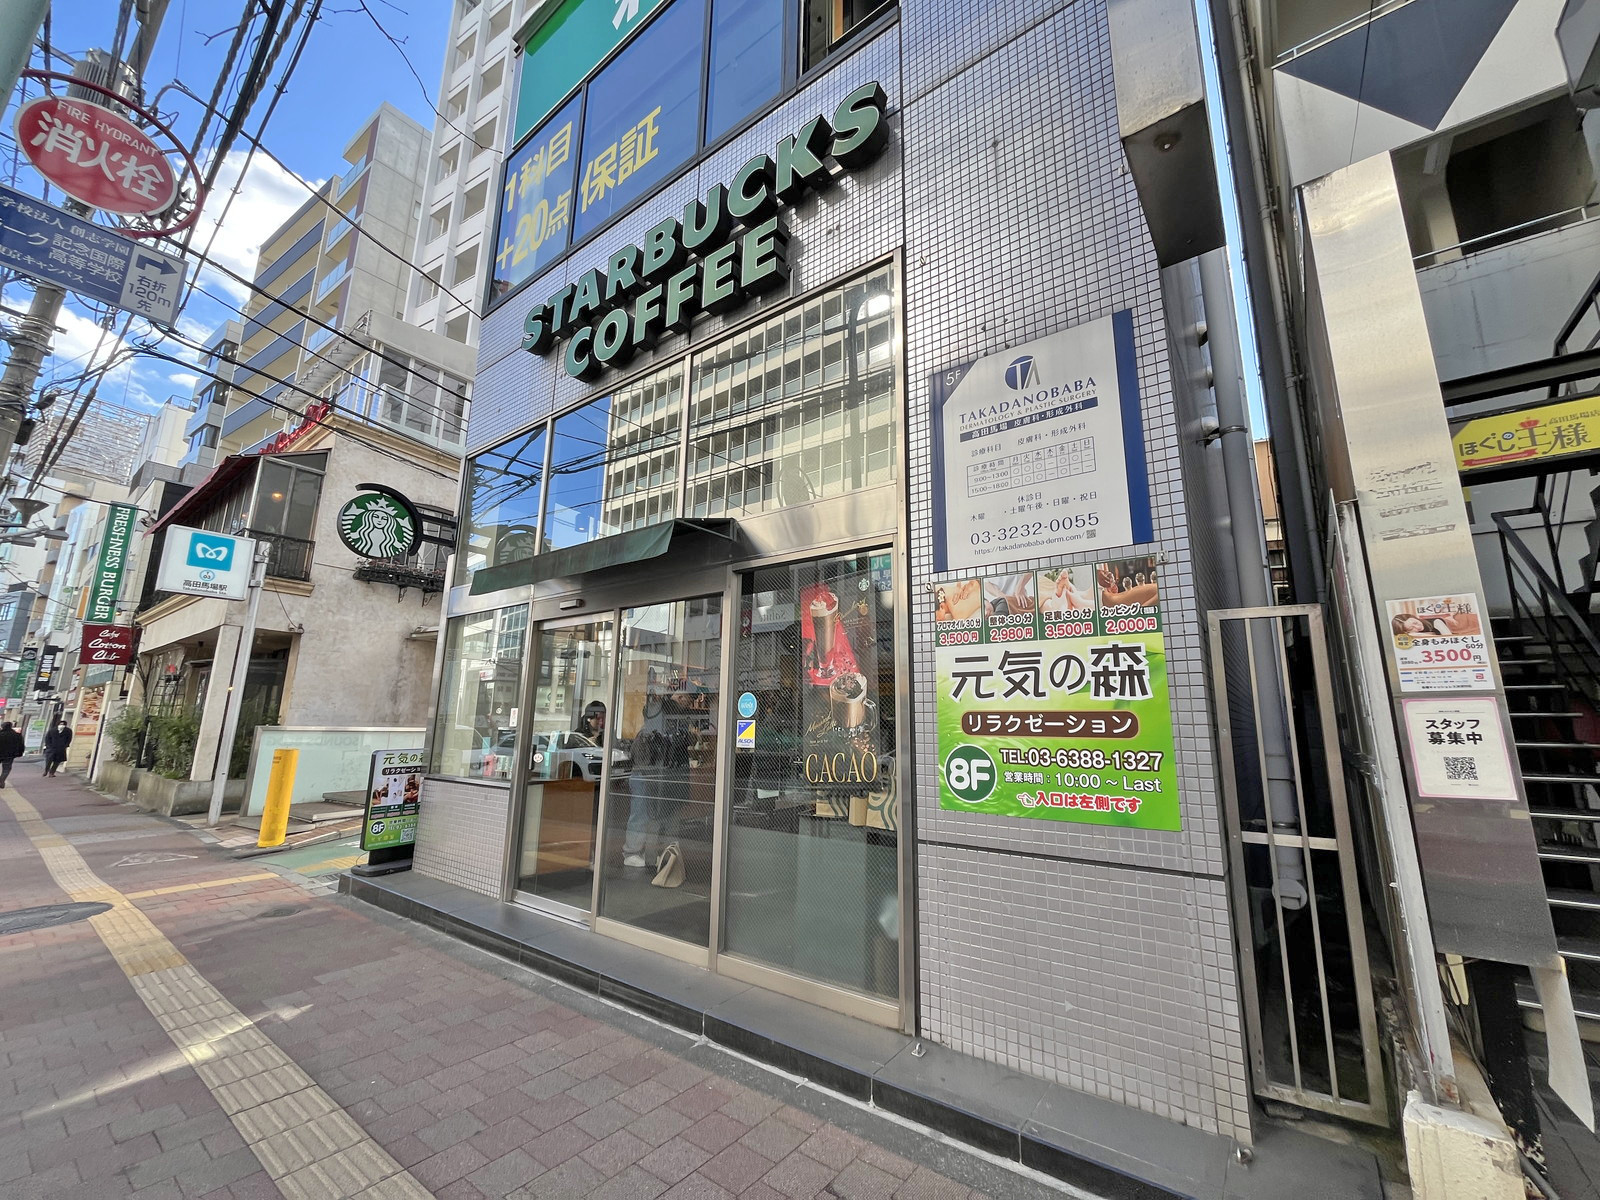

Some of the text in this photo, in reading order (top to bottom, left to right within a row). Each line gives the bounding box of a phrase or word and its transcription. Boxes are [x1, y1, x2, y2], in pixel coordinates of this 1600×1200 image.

[57, 102, 160, 157] FIRE HYDRANT
[30, 110, 165, 201] 消火栓
[505, 120, 572, 212] 1科目
[581, 105, 662, 214] 保証
[521, 80, 890, 354] STARBUCKS
[496, 188, 572, 270] +20点
[53, 233, 126, 272] 記念国際
[48, 247, 123, 285] 高等学校
[138, 275, 167, 292] 右折
[128, 283, 171, 308] 120m
[564, 216, 786, 381] COFFEE
[136, 300, 153, 313] 先
[946, 370, 961, 386] 5F
[960, 377, 1097, 424] TAKADANOBABA
[960, 411, 1015, 431] DERMATOLOGY
[1025, 400, 1056, 413] PLASTIC
[1058, 388, 1097, 403] SURGERY
[971, 421, 1008, 439] 高田馬場
[971, 443, 1002, 458] 診療科目
[1017, 492, 1042, 503] 休診日
[104, 506, 131, 569] FRESHNESS
[970, 512, 1099, 545] 03-3232-0055
[990, 627, 1033, 641] 2,980円
[1046, 623, 1093, 637] 3,500円
[1106, 618, 1156, 633] 2,000円
[940, 632, 978, 645] 3,500円
[1412, 636, 1480, 647] 全身もみほぐし
[1421, 648, 1482, 664] 3,500円
[951, 643, 1149, 699] 元気の森
[968, 714, 1132, 735] リラクゼーション
[1425, 718, 1480, 730] スタッフ
[1427, 731, 1483, 745] 募集中
[385, 767, 421, 775] リラクゼーショ
[805, 750, 878, 784] CACAO
[950, 757, 991, 791] 8F
[1123, 777, 1162, 793] Last
[1035, 792, 1142, 814] 入口は左側です
[372, 823, 384, 833] 8F
